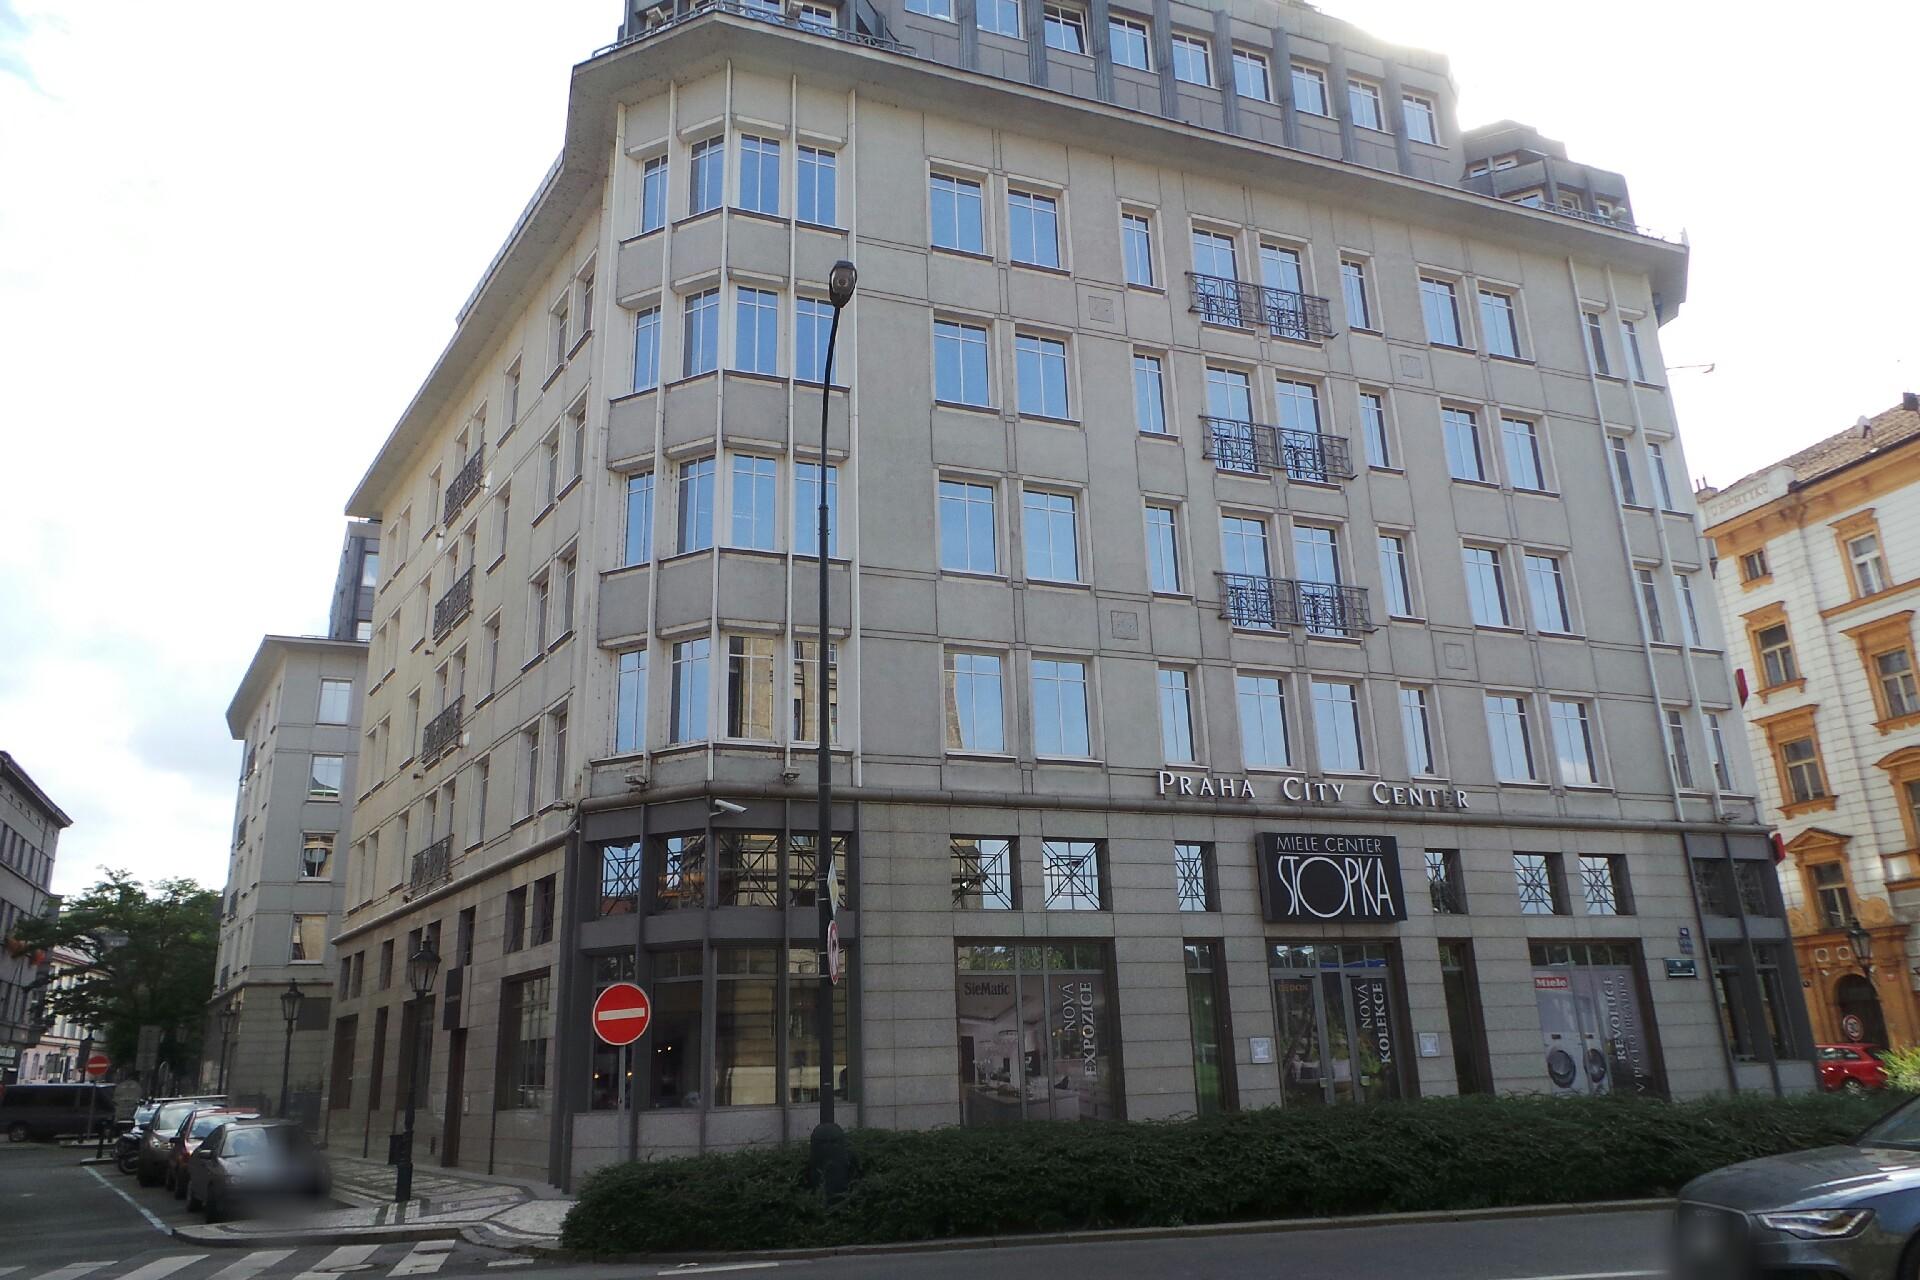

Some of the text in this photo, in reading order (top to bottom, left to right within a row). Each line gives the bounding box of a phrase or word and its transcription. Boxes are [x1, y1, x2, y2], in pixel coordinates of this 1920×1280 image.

[1159, 771, 1256, 799] PRAHA
[1283, 777, 1344, 802] CITY
[1276, 836, 1382, 853] MIELE CENTER
[1277, 856, 1396, 918] STOPKA
[964, 982, 1010, 996] SieMatic
[1535, 978, 1567, 987] Miele
[1058, 983, 1076, 1031] NOVÁ
[1355, 984, 1373, 1029] NOVÁ
[1373, 984, 1392, 1064] KOLEKCE
[1080, 982, 1097, 1077] EXPOZICE
